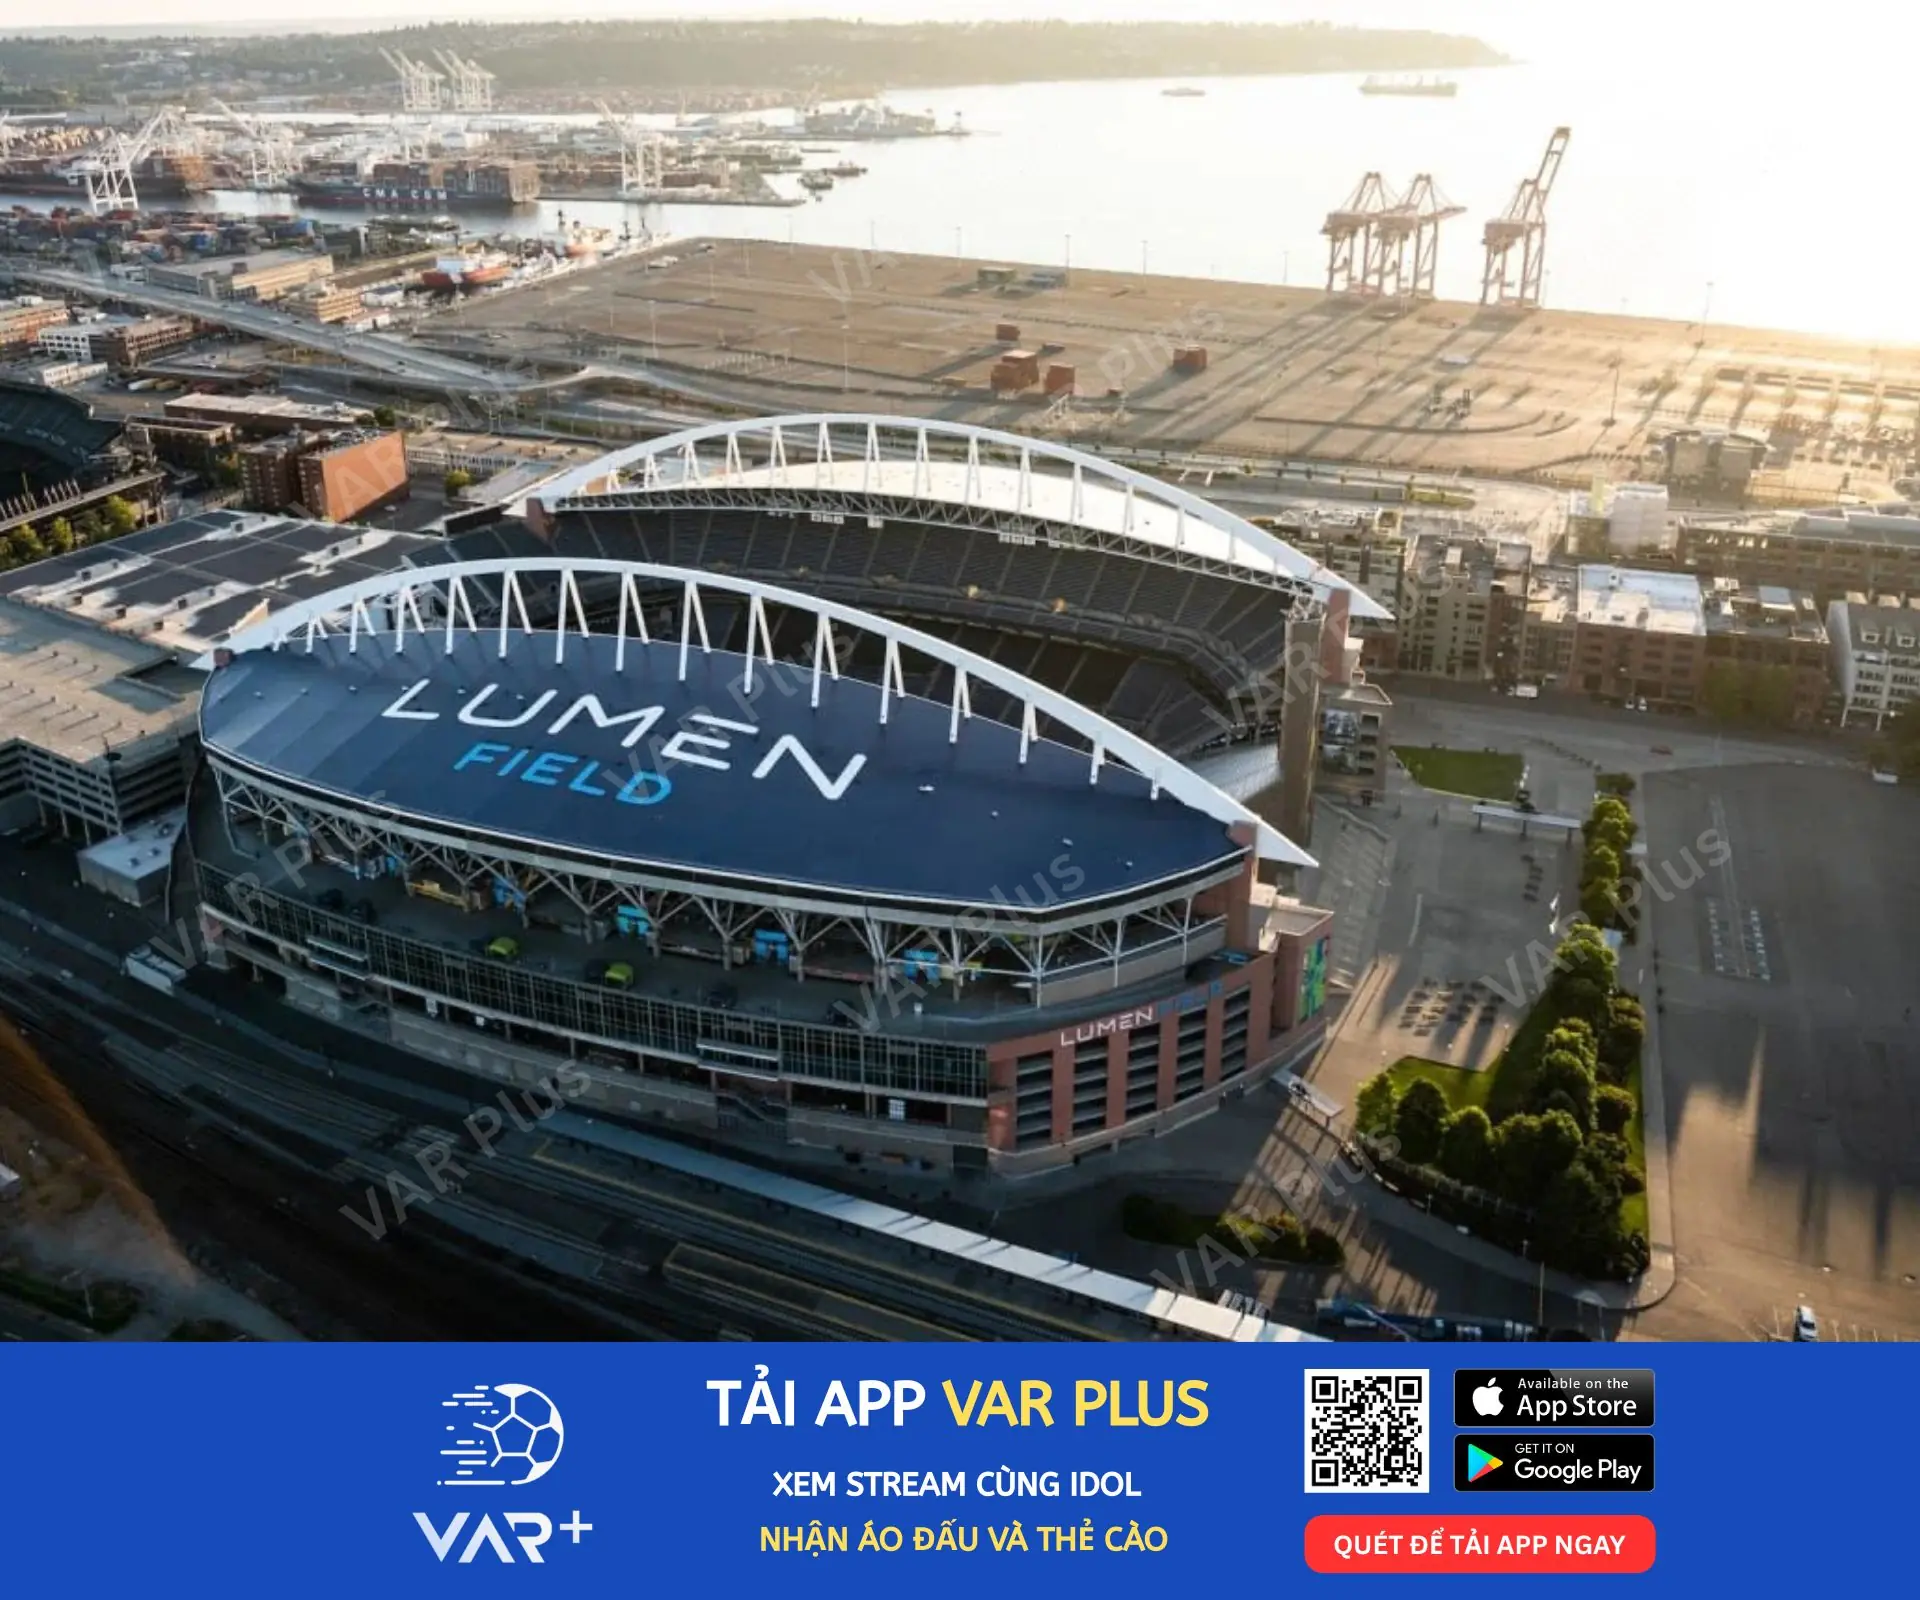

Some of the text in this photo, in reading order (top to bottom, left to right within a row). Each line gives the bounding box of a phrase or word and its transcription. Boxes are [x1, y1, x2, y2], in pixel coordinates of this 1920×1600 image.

[362, 187, 399, 199] CMA
[382, 678, 867, 800] LUMEN
[453, 742, 673, 805] FIELD
[1060, 1005, 1154, 1047] LUMEN
